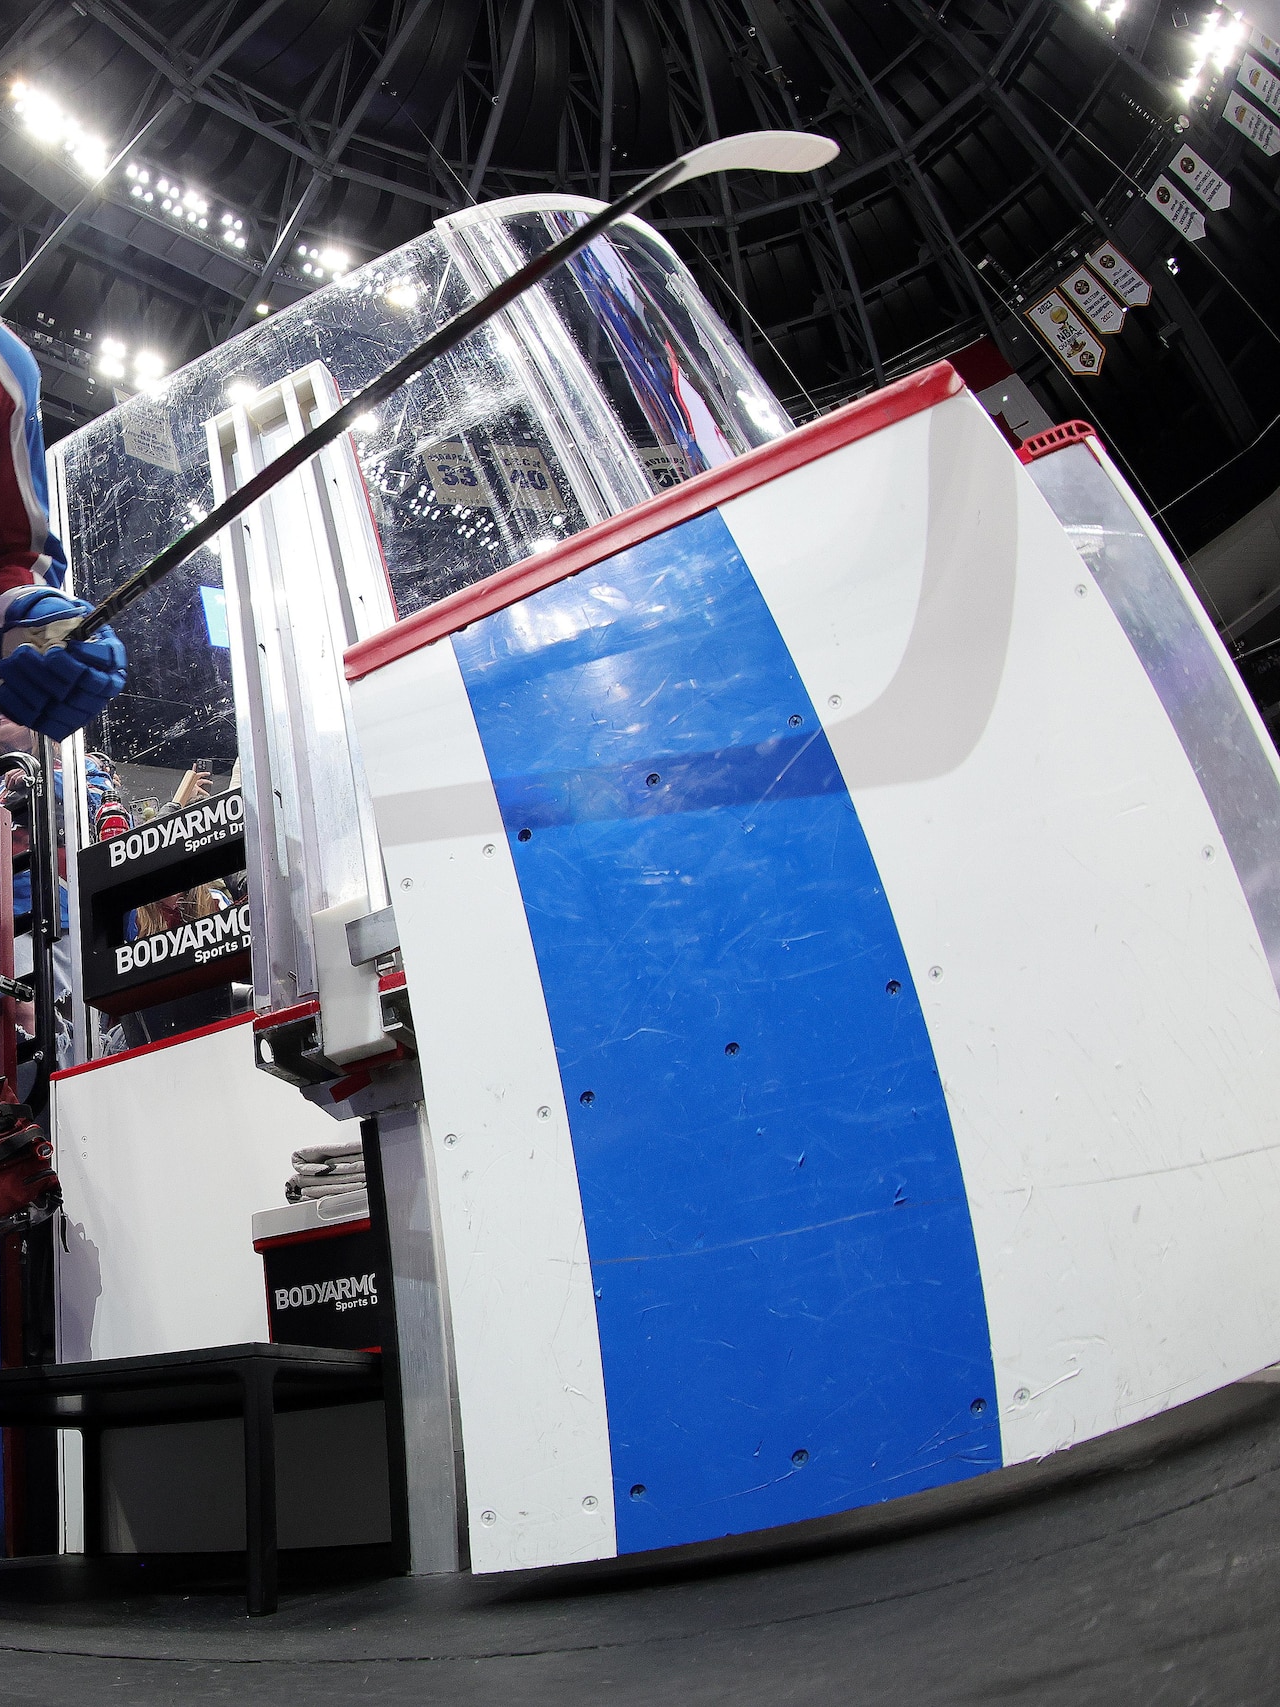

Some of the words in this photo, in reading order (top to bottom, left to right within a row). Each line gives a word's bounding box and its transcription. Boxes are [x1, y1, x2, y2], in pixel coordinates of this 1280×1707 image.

[1037, 301, 1054, 315] 2023
[1056, 324, 1078, 343] NBA
[437, 465, 478, 486] 33
[510, 469, 548, 490] 40
[108, 794, 244, 868] BODYARMO
[184, 828, 226, 852] Sports
[194, 940, 238, 964] Sports
[335, 1297, 368, 1312] Sports
